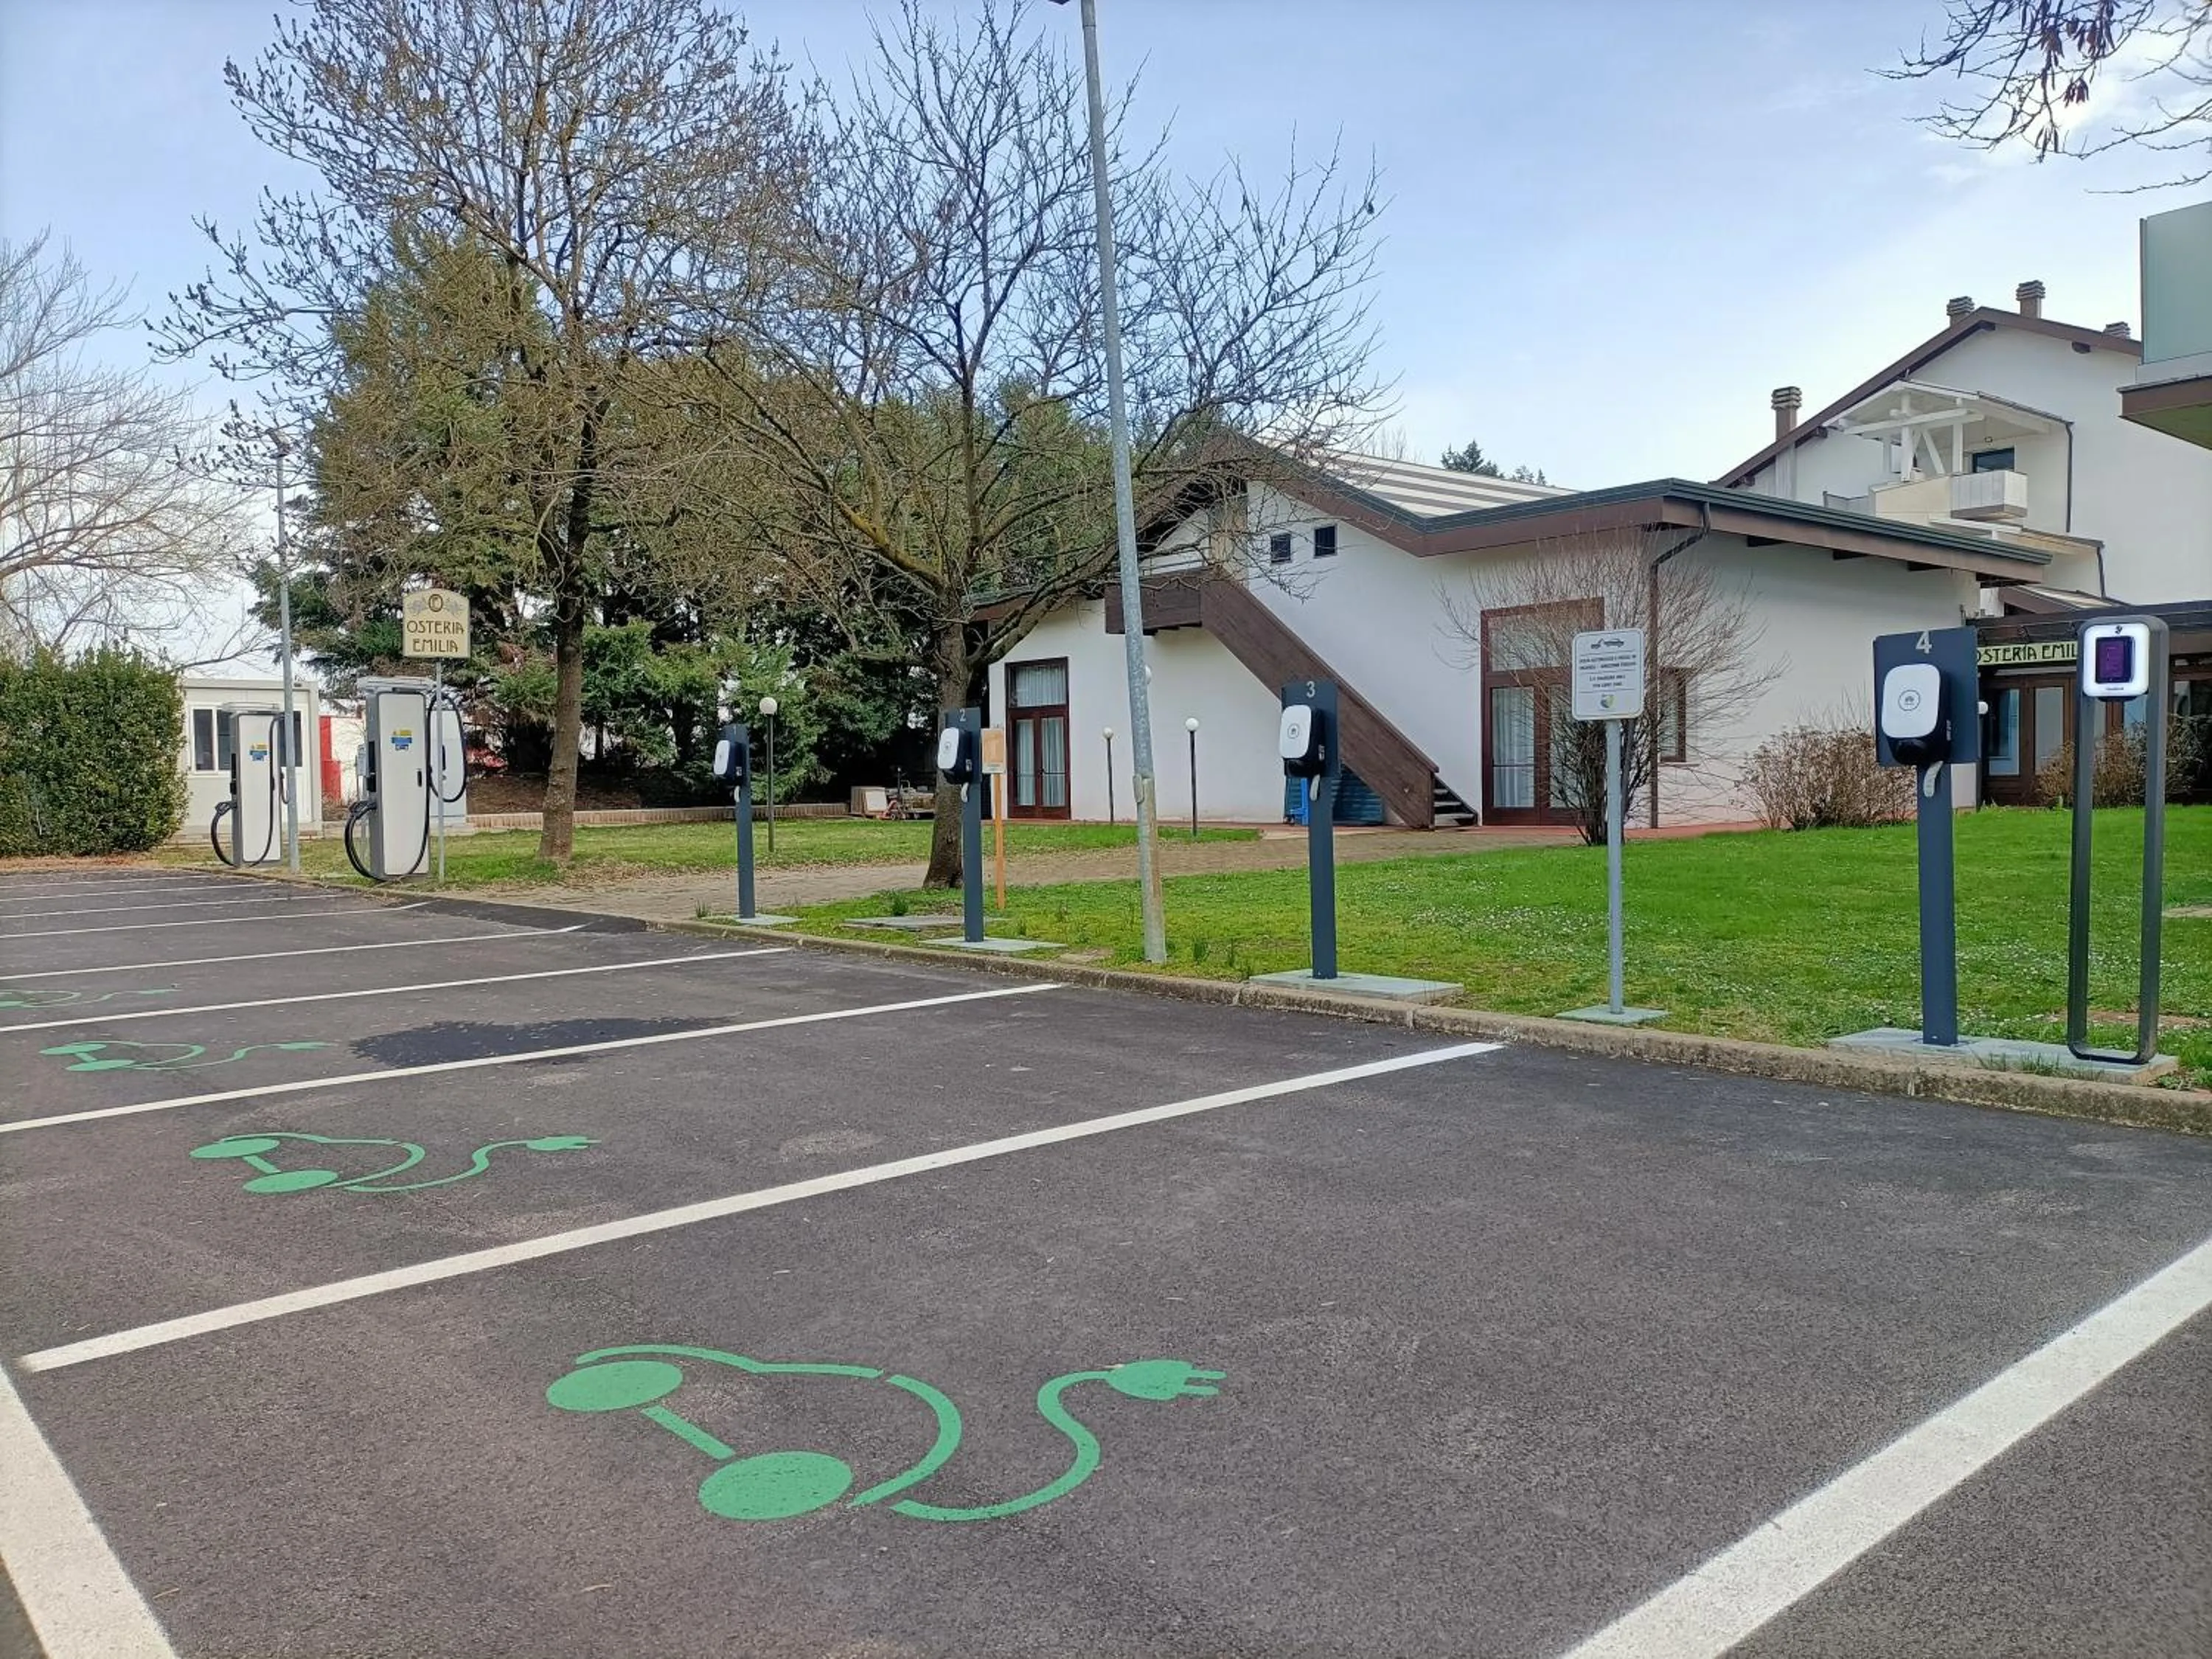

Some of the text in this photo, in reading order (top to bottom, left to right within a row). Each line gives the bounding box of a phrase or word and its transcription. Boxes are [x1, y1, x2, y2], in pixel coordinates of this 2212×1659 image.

[406, 620, 465, 635] OSTERIA
[412, 638, 459, 653] EMILIA
[1915, 630, 1933, 654] 4
[1306, 681, 1315, 698] 3
[959, 708, 967, 722] 2
